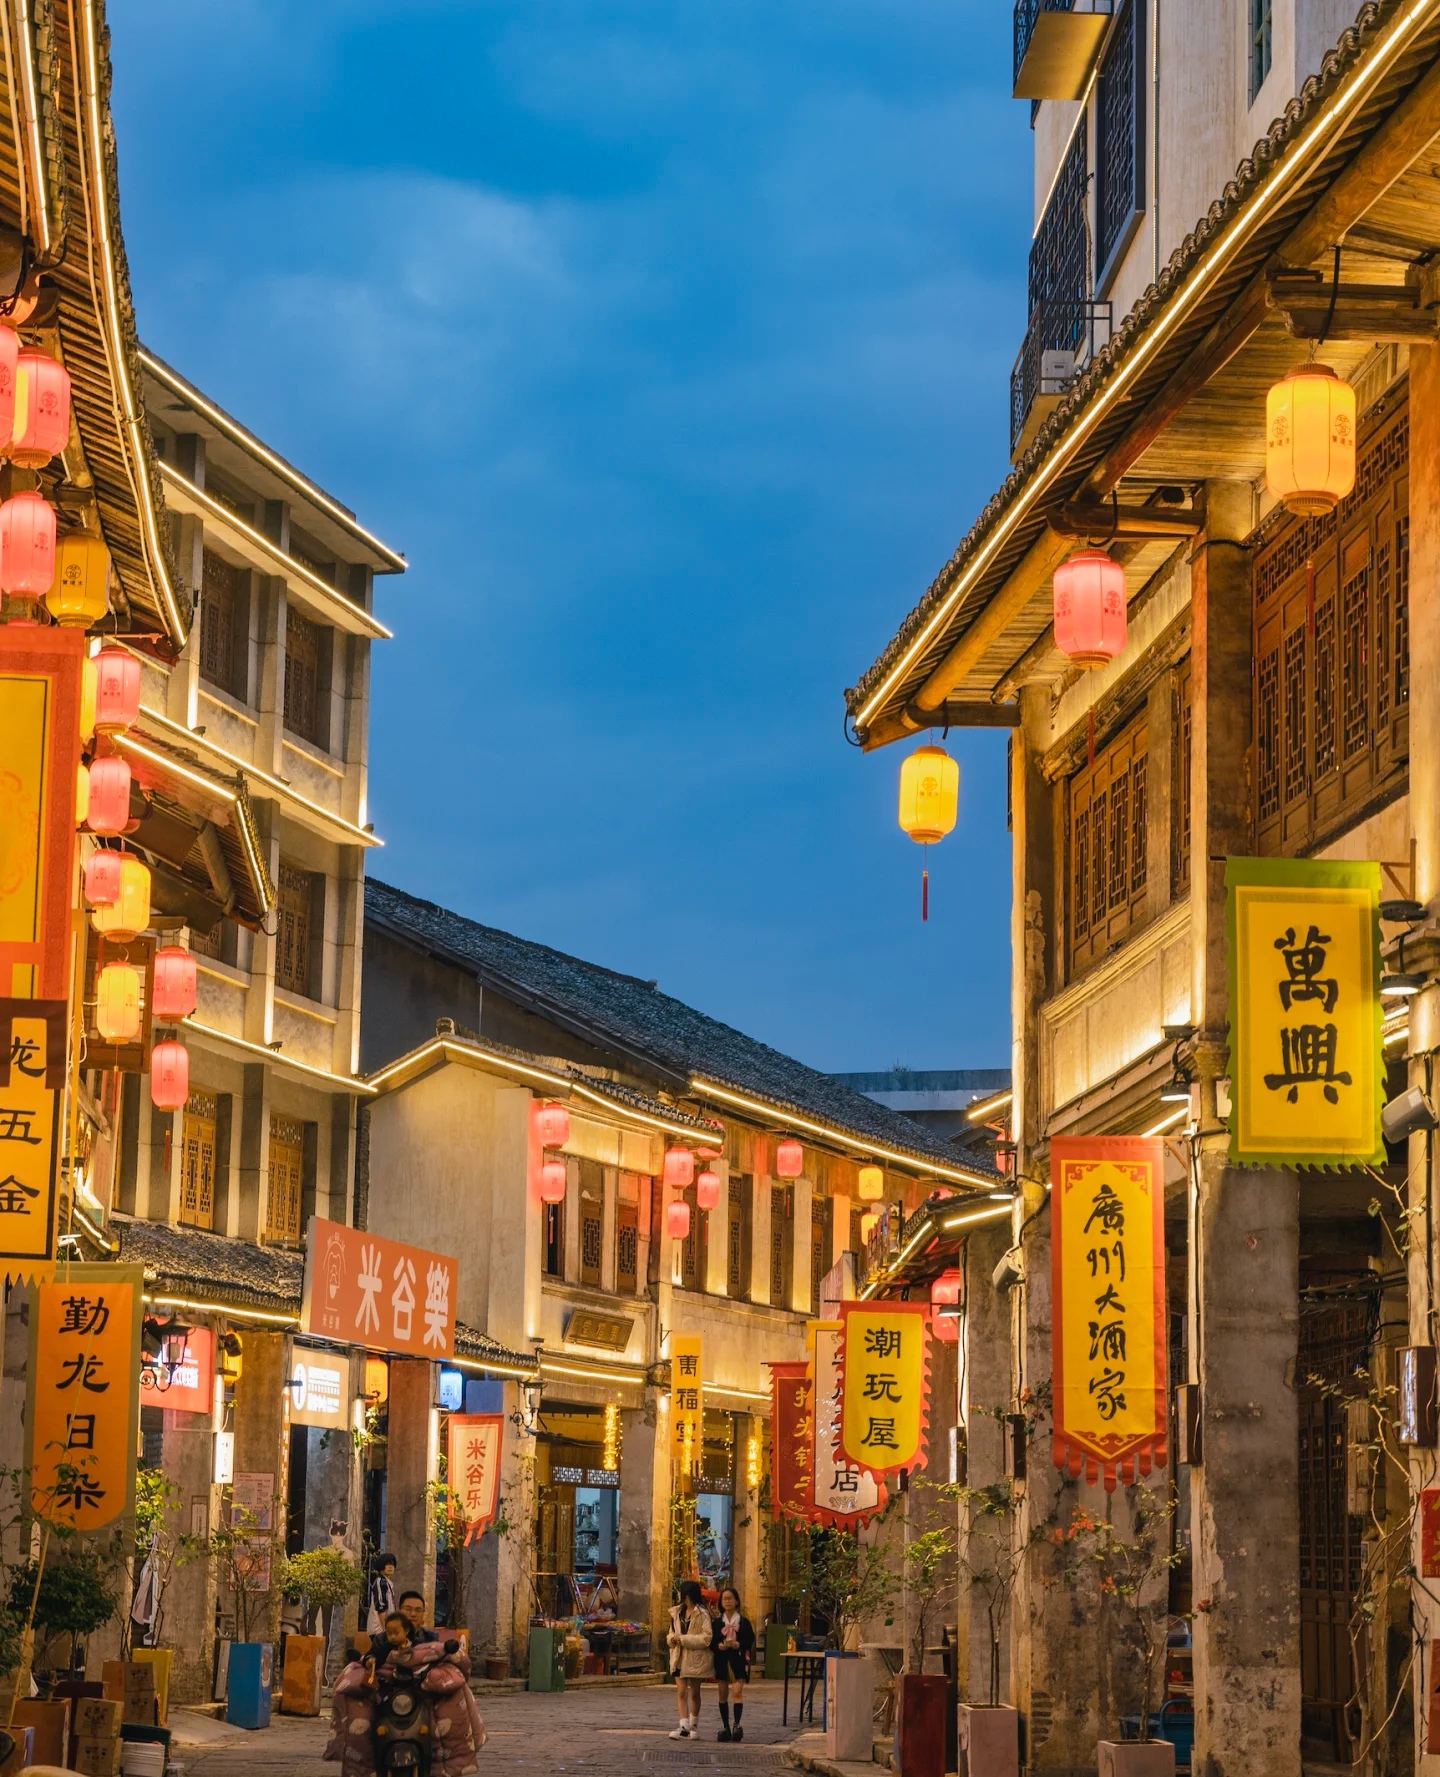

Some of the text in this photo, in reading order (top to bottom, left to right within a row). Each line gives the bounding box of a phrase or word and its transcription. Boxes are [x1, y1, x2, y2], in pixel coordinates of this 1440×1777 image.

[1263, 925, 1353, 1105] 萬興
[355, 1243, 450, 1350] 米谷樂
[1083, 1184, 1128, 1421] 廣州大酒家
[861, 1327, 902, 1450] 潮玩屋
[466, 1438, 486, 1510] 米谷乐
